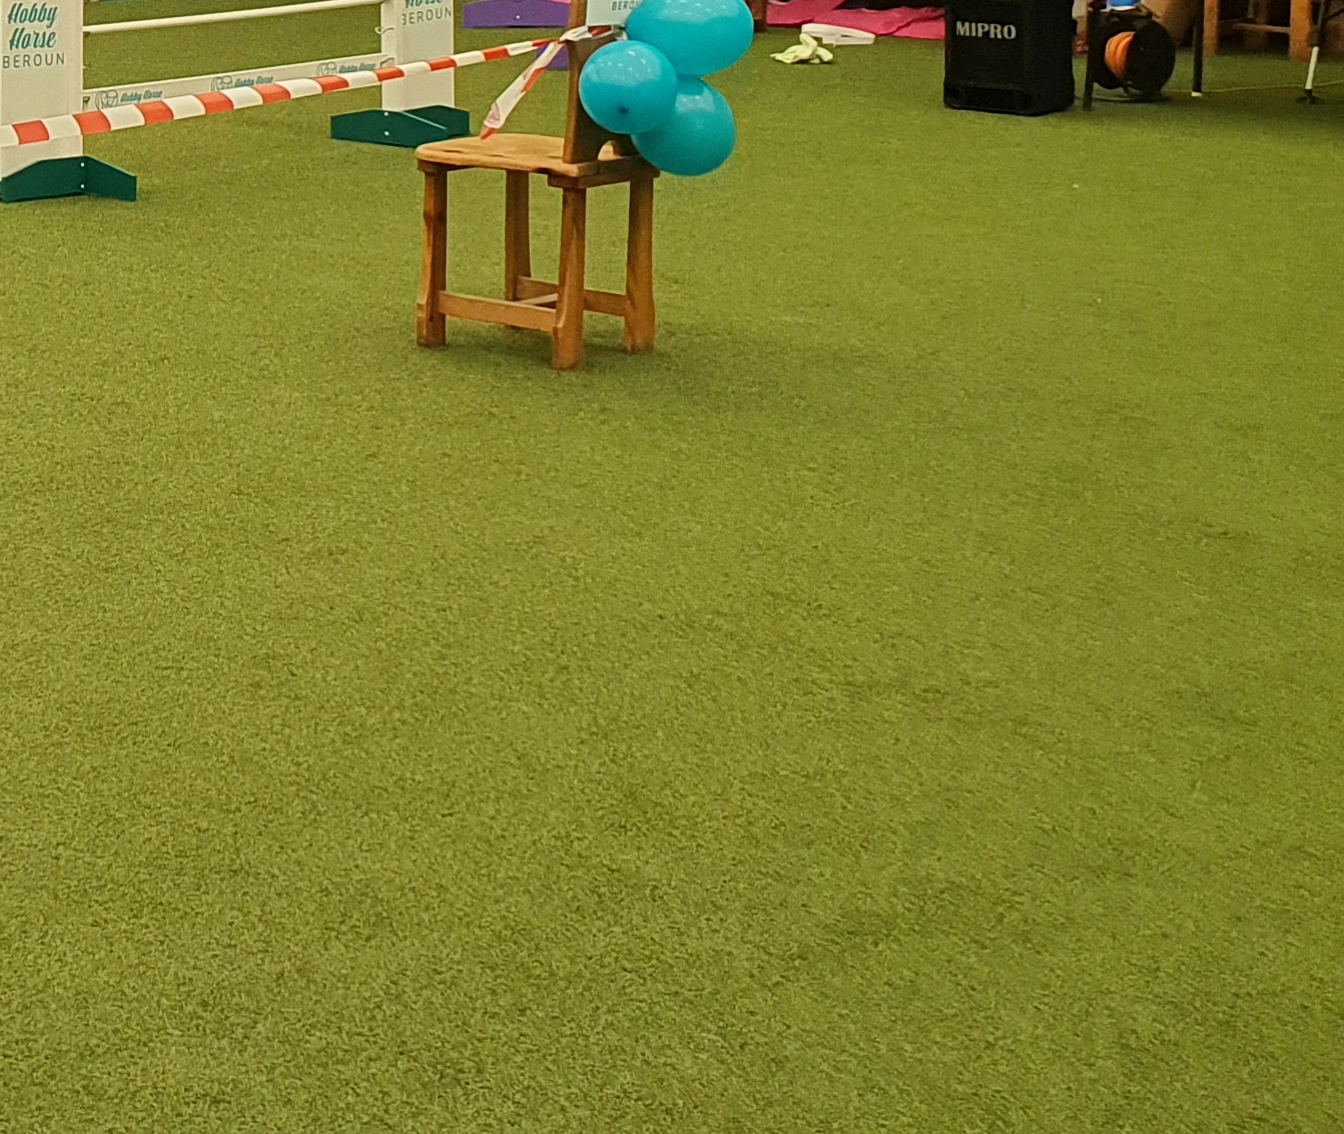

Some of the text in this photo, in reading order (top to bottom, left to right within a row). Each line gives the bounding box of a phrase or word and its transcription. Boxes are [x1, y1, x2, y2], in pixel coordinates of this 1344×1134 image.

[7, 2, 58, 28] Hobby
[9, 27, 57, 50] Horse
[956, 21, 1017, 40] MIPRO
[2, 53, 65, 69] BEROUN
